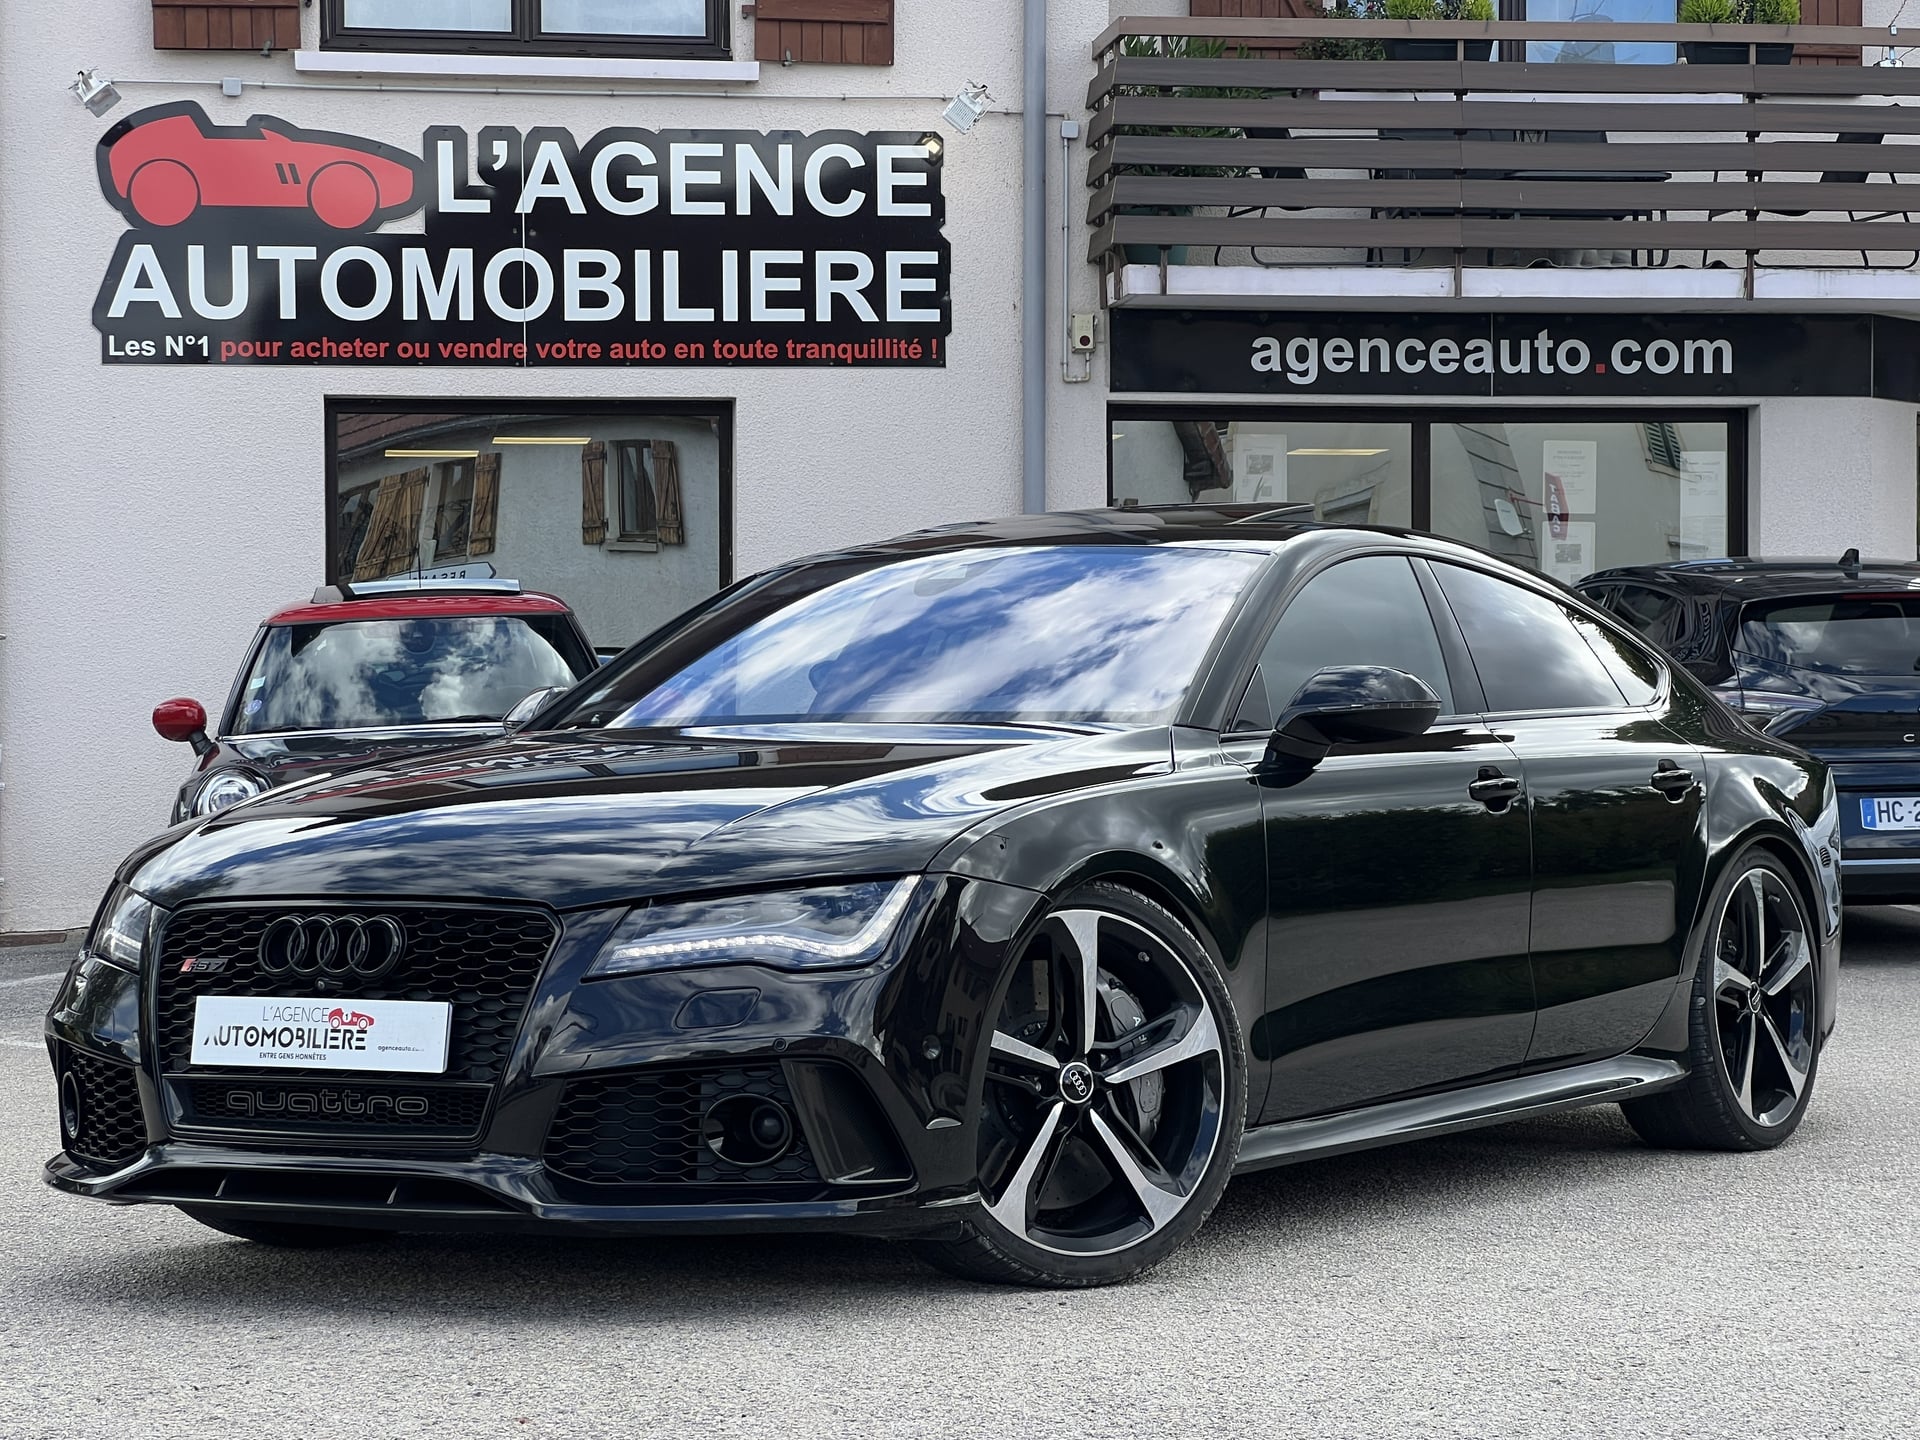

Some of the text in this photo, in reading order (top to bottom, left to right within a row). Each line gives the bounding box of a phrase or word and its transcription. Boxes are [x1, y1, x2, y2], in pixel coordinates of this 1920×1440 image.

[107, 243, 941, 323] AUTOMOBILIERE
[108, 335, 156, 357] Les
[165, 335, 209, 357] N°1
[220, 341, 282, 361] pour
[290, 337, 390, 359] acheter
[397, 342, 430, 359] ou
[438, 338, 526, 359] vendre
[536, 339, 602, 359] votre
[609, 339, 667, 359] auto
[674, 343, 705, 359] en
[713, 339, 779, 359] toute
[786, 337, 923, 364] tranquillité
[1250, 328, 1733, 385] agenceauto.com
[203, 1025, 368, 1051] AUTOMOBILIERE
[259, 1051, 277, 1059] ENTRE
[278, 1052, 294, 1060] GENS
[226, 1088, 429, 1117] quattro
